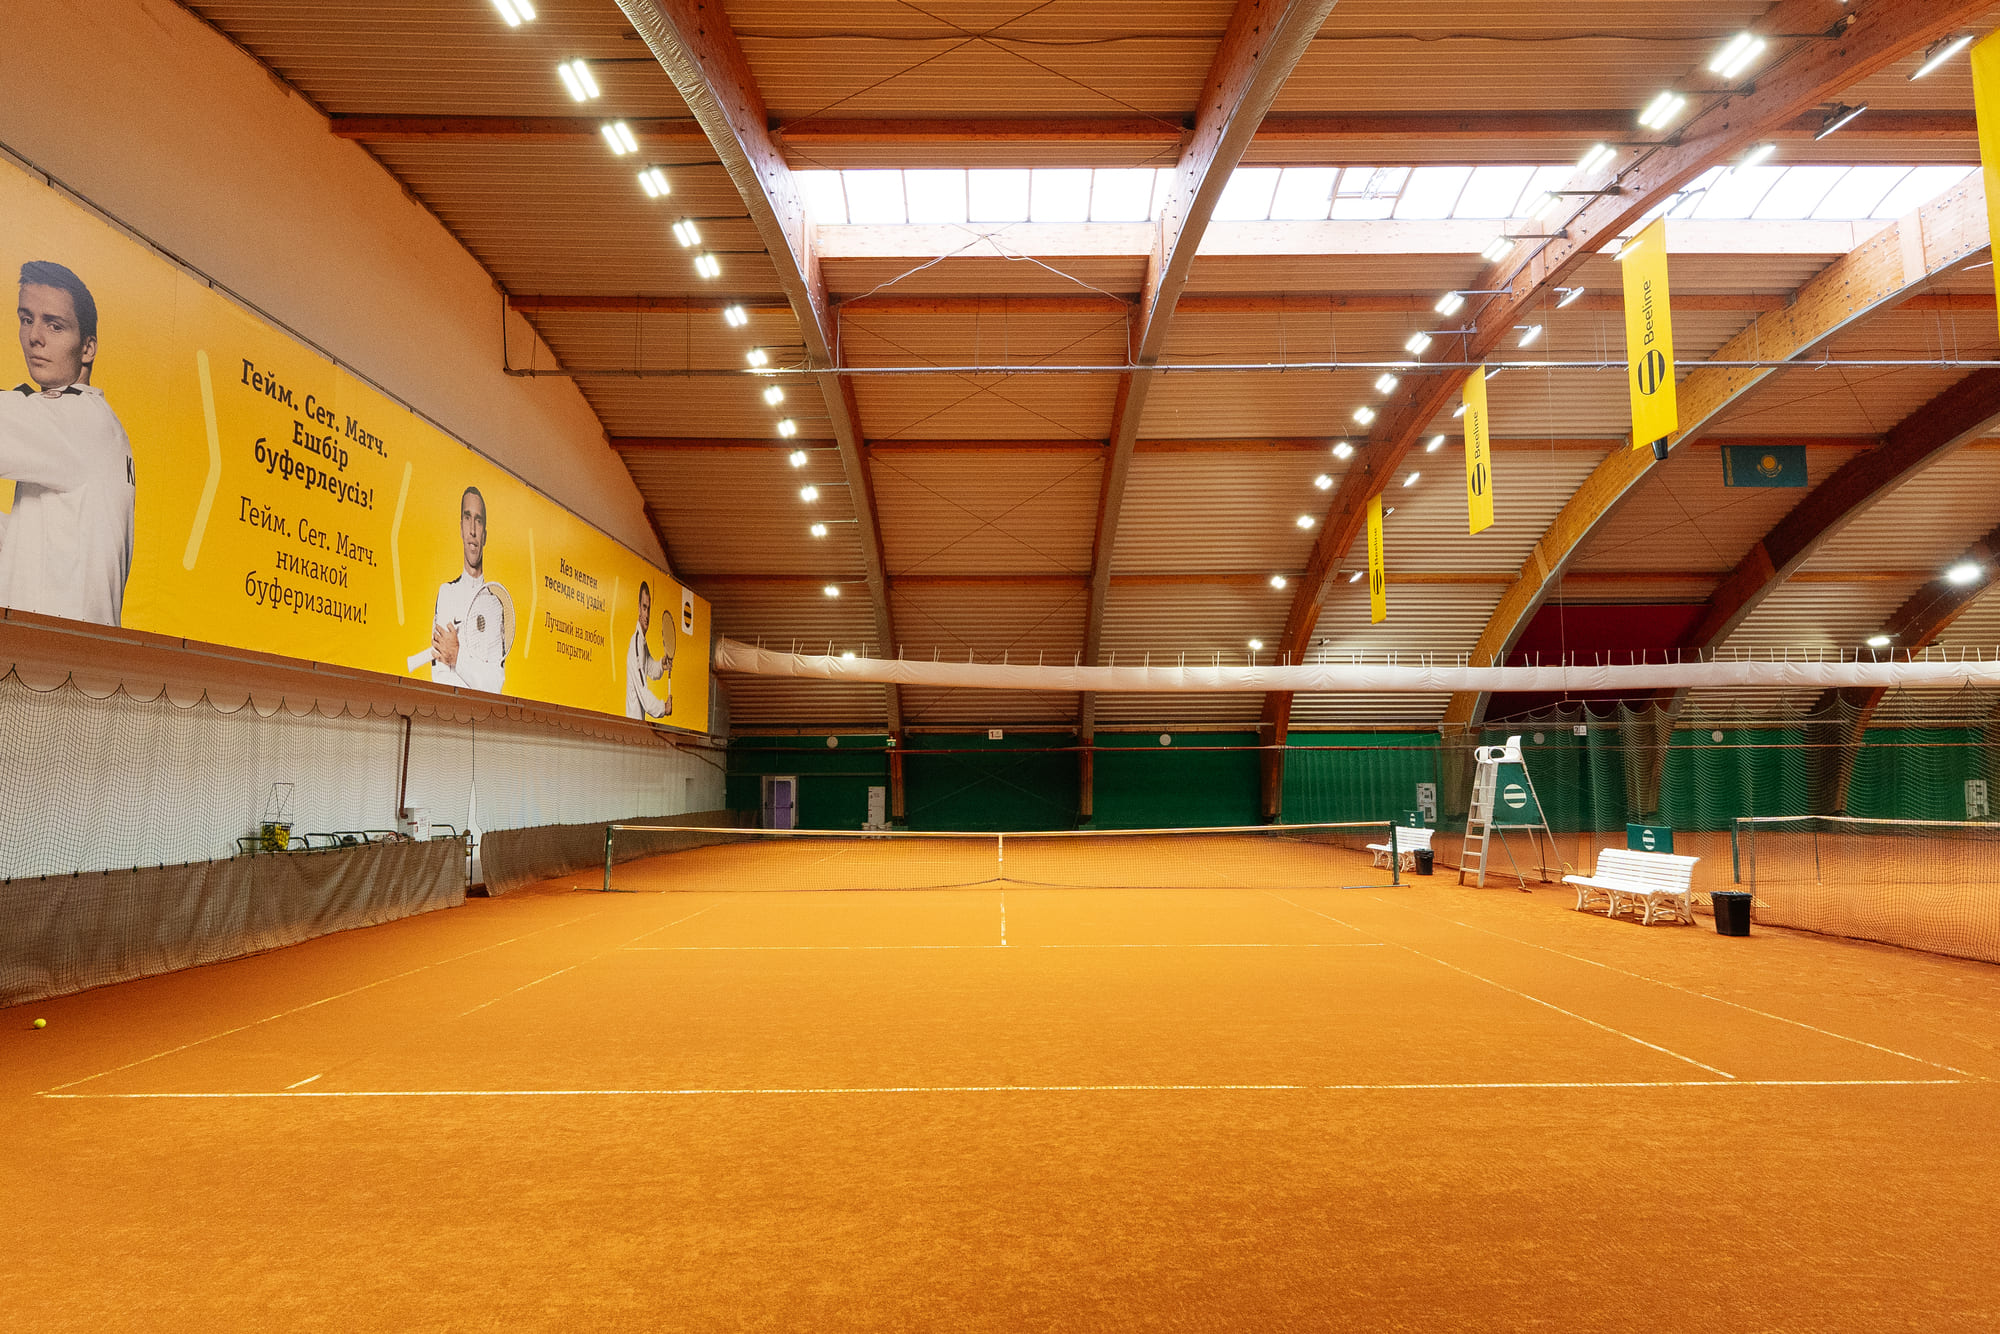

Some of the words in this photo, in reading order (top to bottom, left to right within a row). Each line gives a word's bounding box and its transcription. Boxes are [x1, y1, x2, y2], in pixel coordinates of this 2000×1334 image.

[1642, 280, 1655, 346] Beeline
[241, 359, 299, 411] Гейм.
[305, 394, 340, 432] Сет.
[345, 416, 388, 458] Матч.
[292, 420, 349, 471] Ешбір
[254, 437, 374, 510] буферлеусіз!
[239, 495, 291, 538] Гейм.
[298, 518, 330, 551] Сет.
[336, 532, 378, 568] Матч.
[276, 550, 348, 588] никакой
[545, 576, 575, 600] төсемде
[560, 558, 573, 578] Кез
[574, 569, 597, 589] келген
[245, 570, 368, 625] буферизации!
[545, 611, 574, 636] Лучший
[575, 627, 583, 639] на
[585, 629, 605, 647] любом
[557, 641, 592, 662] покрытии!
